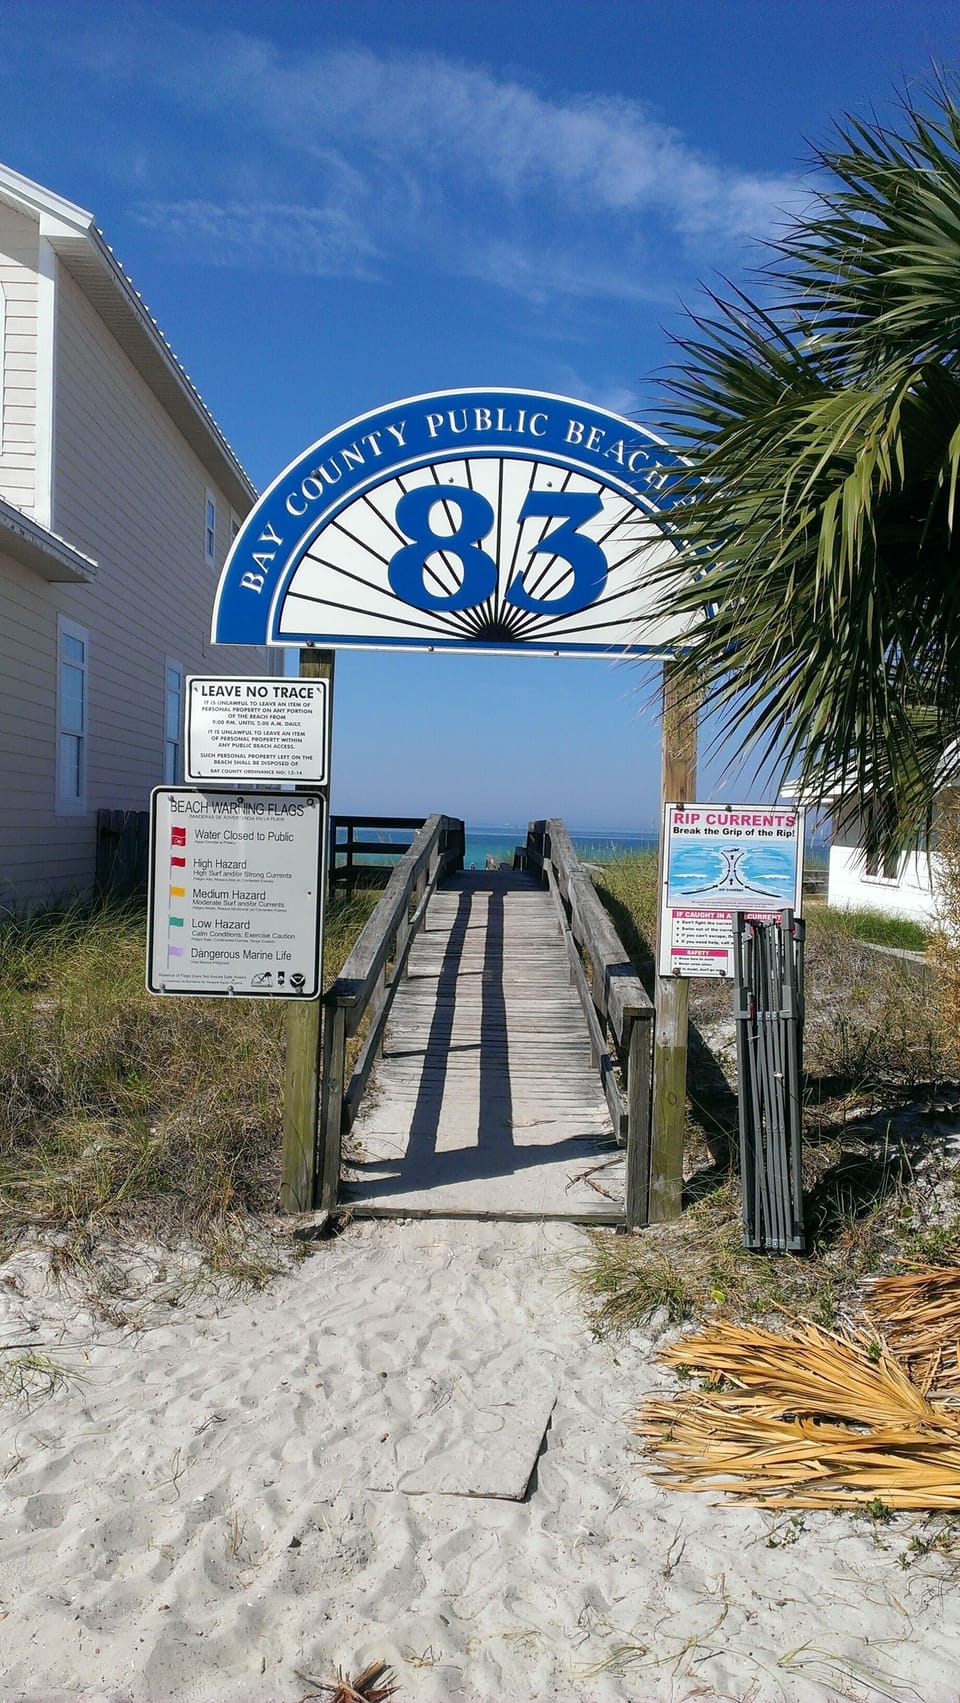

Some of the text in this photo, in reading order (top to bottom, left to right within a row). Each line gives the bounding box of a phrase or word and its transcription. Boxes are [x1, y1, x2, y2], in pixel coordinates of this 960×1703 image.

[238, 407, 671, 594] BAY COUNTY PUBLIC BEACH
[387, 484, 608, 616] 83
[201, 686, 314, 699] LEAVE NO TRACE
[170, 800, 208, 813] BEACH
[267, 803, 304, 816] FLAGS
[674, 813, 796, 827] RIP CURRENTS
[194, 829, 294, 841] Water Closed to Public
[704, 827, 720, 835] the
[722, 828, 742, 837] Grip
[776, 830, 795, 838] Rip!
[193, 858, 247, 870] High Hazard
[193, 888, 266, 900] Medium Hazard
[191, 918, 250, 929] Low Hazard
[191, 948, 292, 960] Dangerous Marine Life
